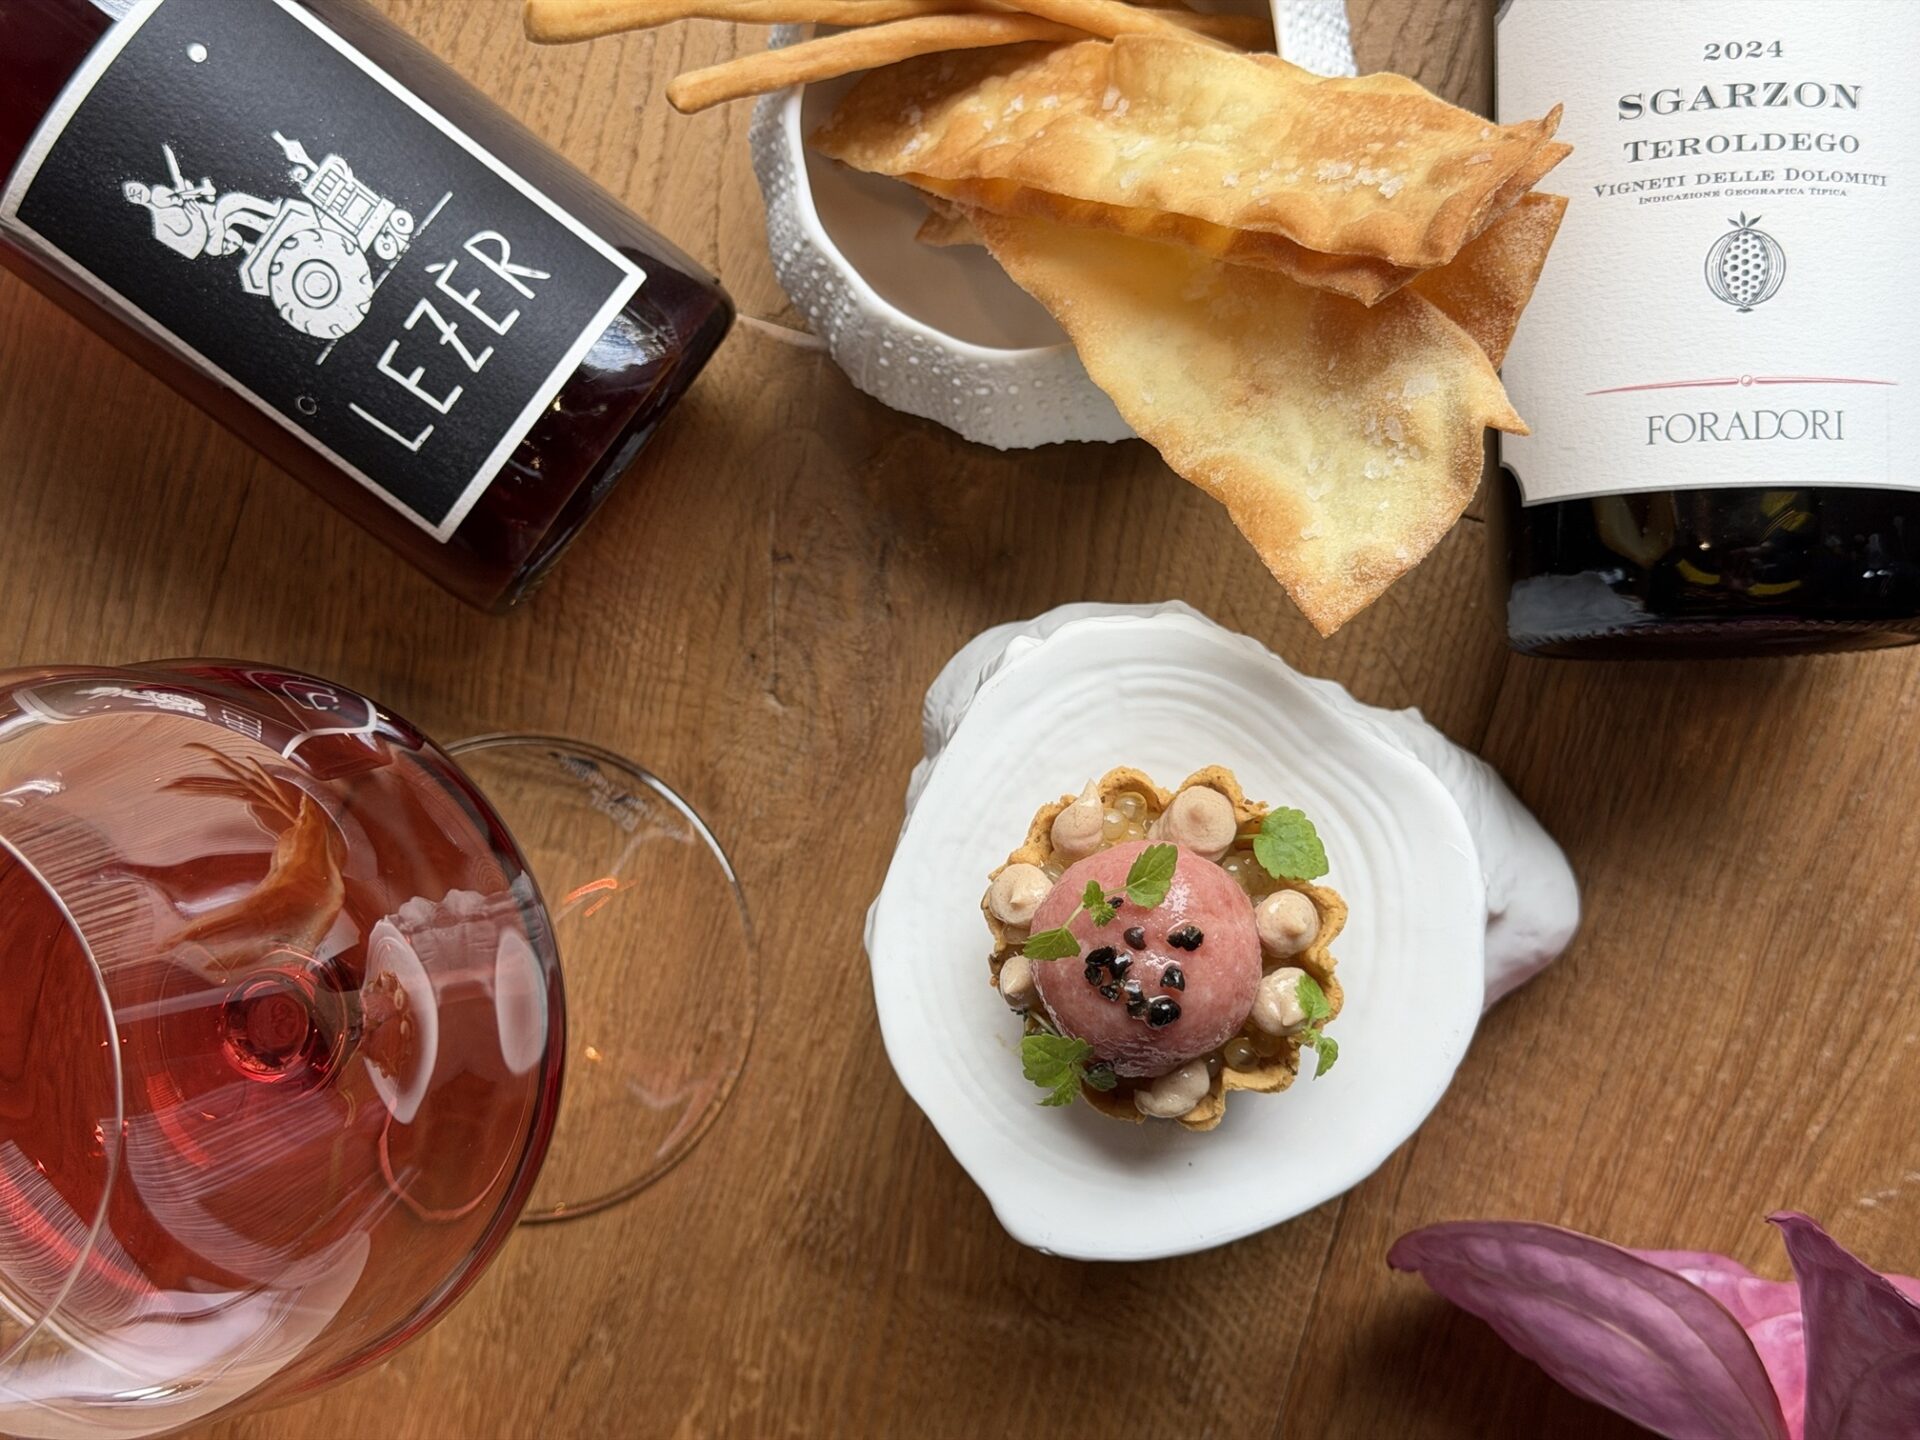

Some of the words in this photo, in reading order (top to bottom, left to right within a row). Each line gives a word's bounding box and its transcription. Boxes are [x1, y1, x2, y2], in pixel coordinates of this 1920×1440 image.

[1703, 40, 1784, 61] 2024
[1618, 81, 1862, 121] SGARZON
[1623, 132, 1860, 163] TEROLDEGO
[1594, 175, 1687, 198] VIGNETI
[1694, 170, 1775, 185] DELLE
[1785, 167, 1888, 187] DOLOMITI
[1638, 190, 1721, 205] INDICAZIONE
[1724, 187, 1805, 197] GEOGRAFICA
[1808, 187, 1847, 197] TIPICA
[1645, 409, 1844, 446] FORADORI
